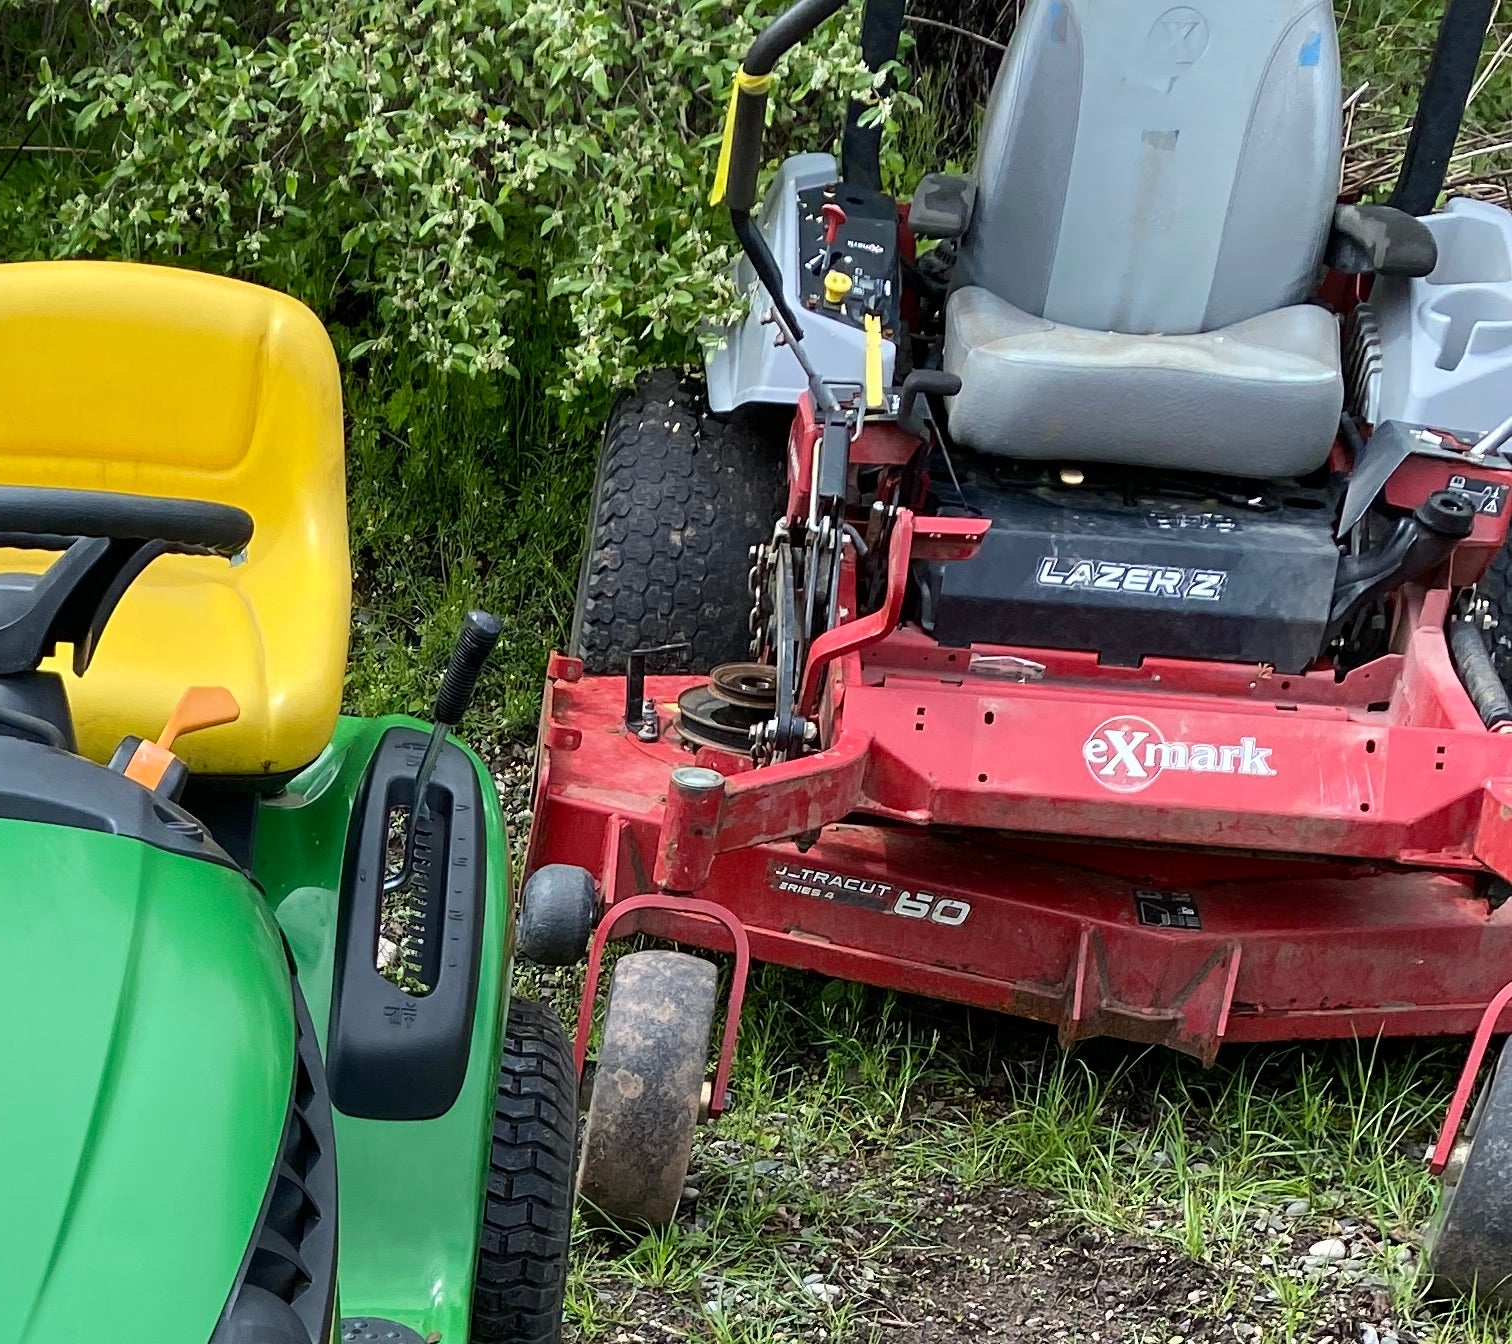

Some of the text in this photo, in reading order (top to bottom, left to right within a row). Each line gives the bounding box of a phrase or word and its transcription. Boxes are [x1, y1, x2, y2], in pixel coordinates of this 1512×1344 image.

[1037, 557, 1226, 601] LAZER Z
[778, 882, 835, 901] ERIES 4
[893, 890, 972, 926] 60
